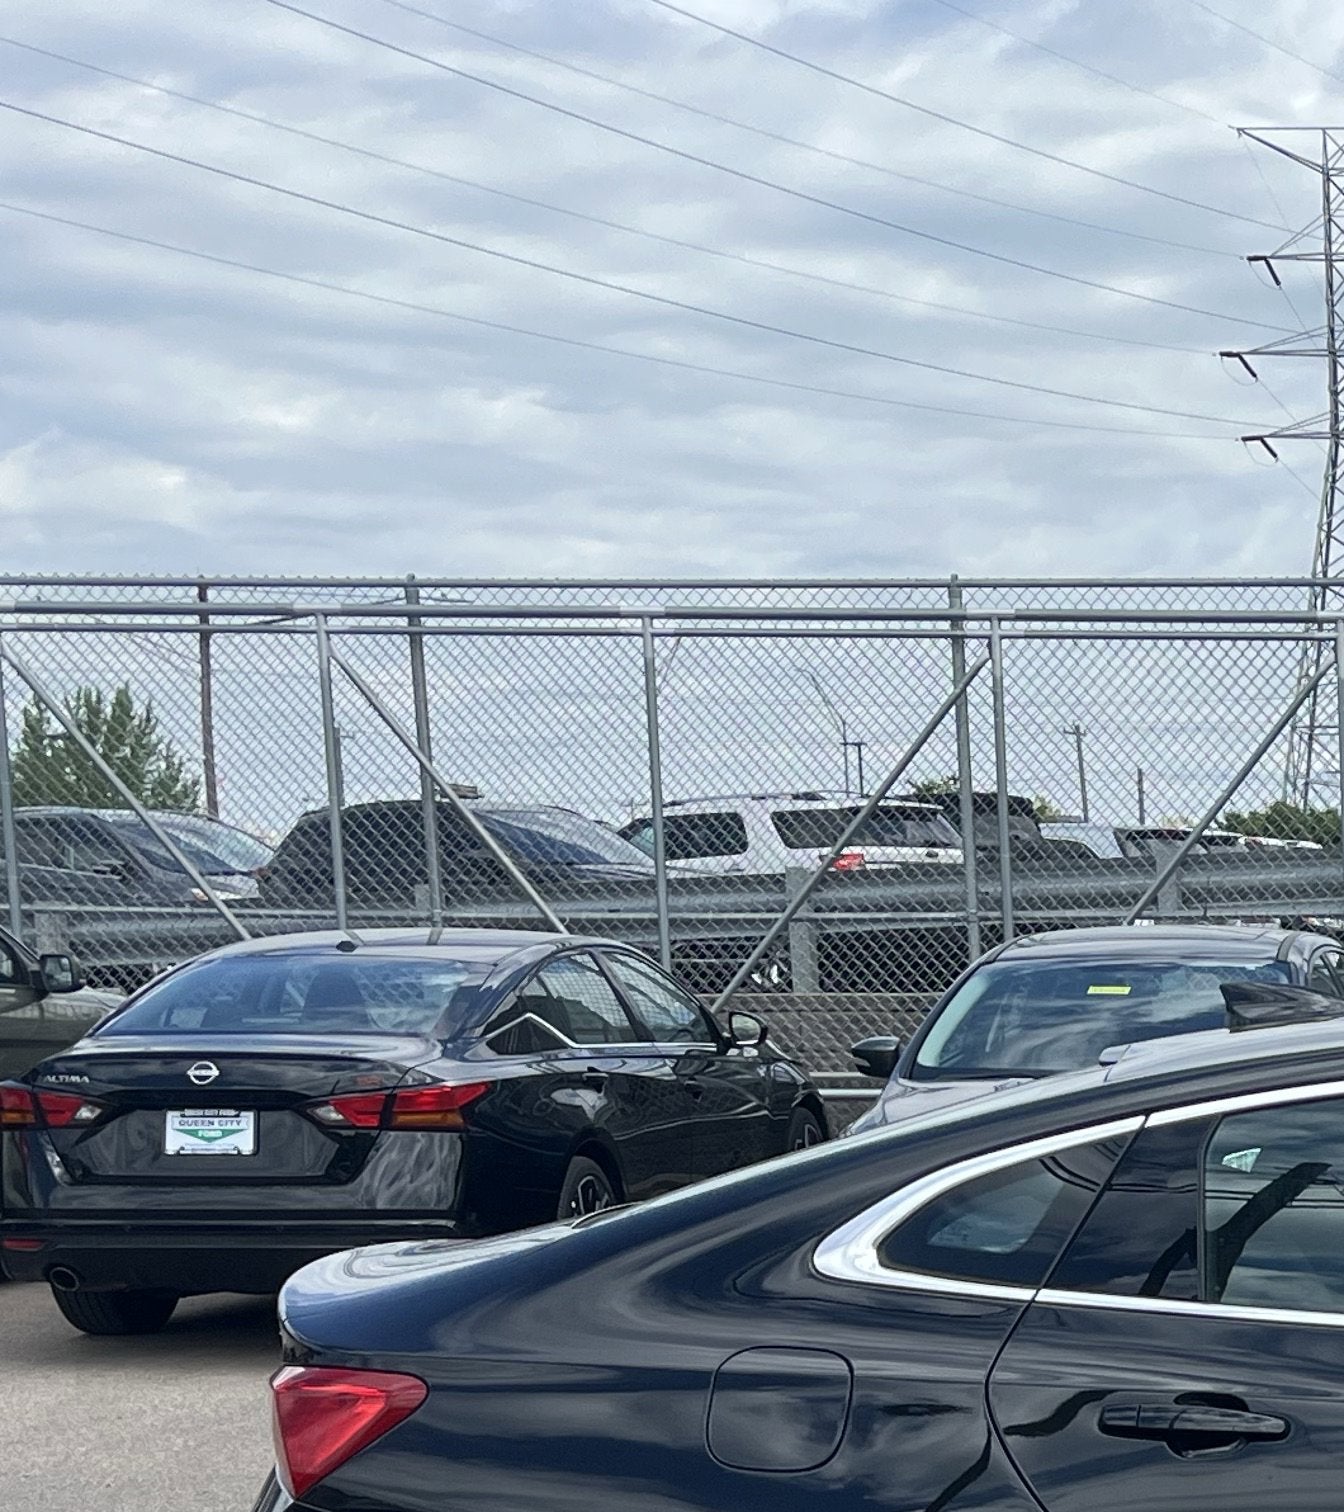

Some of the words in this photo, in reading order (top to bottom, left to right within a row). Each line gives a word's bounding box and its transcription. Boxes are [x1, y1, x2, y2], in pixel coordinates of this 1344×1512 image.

[43, 1075, 89, 1083] ALTIMA
[178, 1119, 214, 1127] QUEEN
[217, 1119, 242, 1127] CITY
